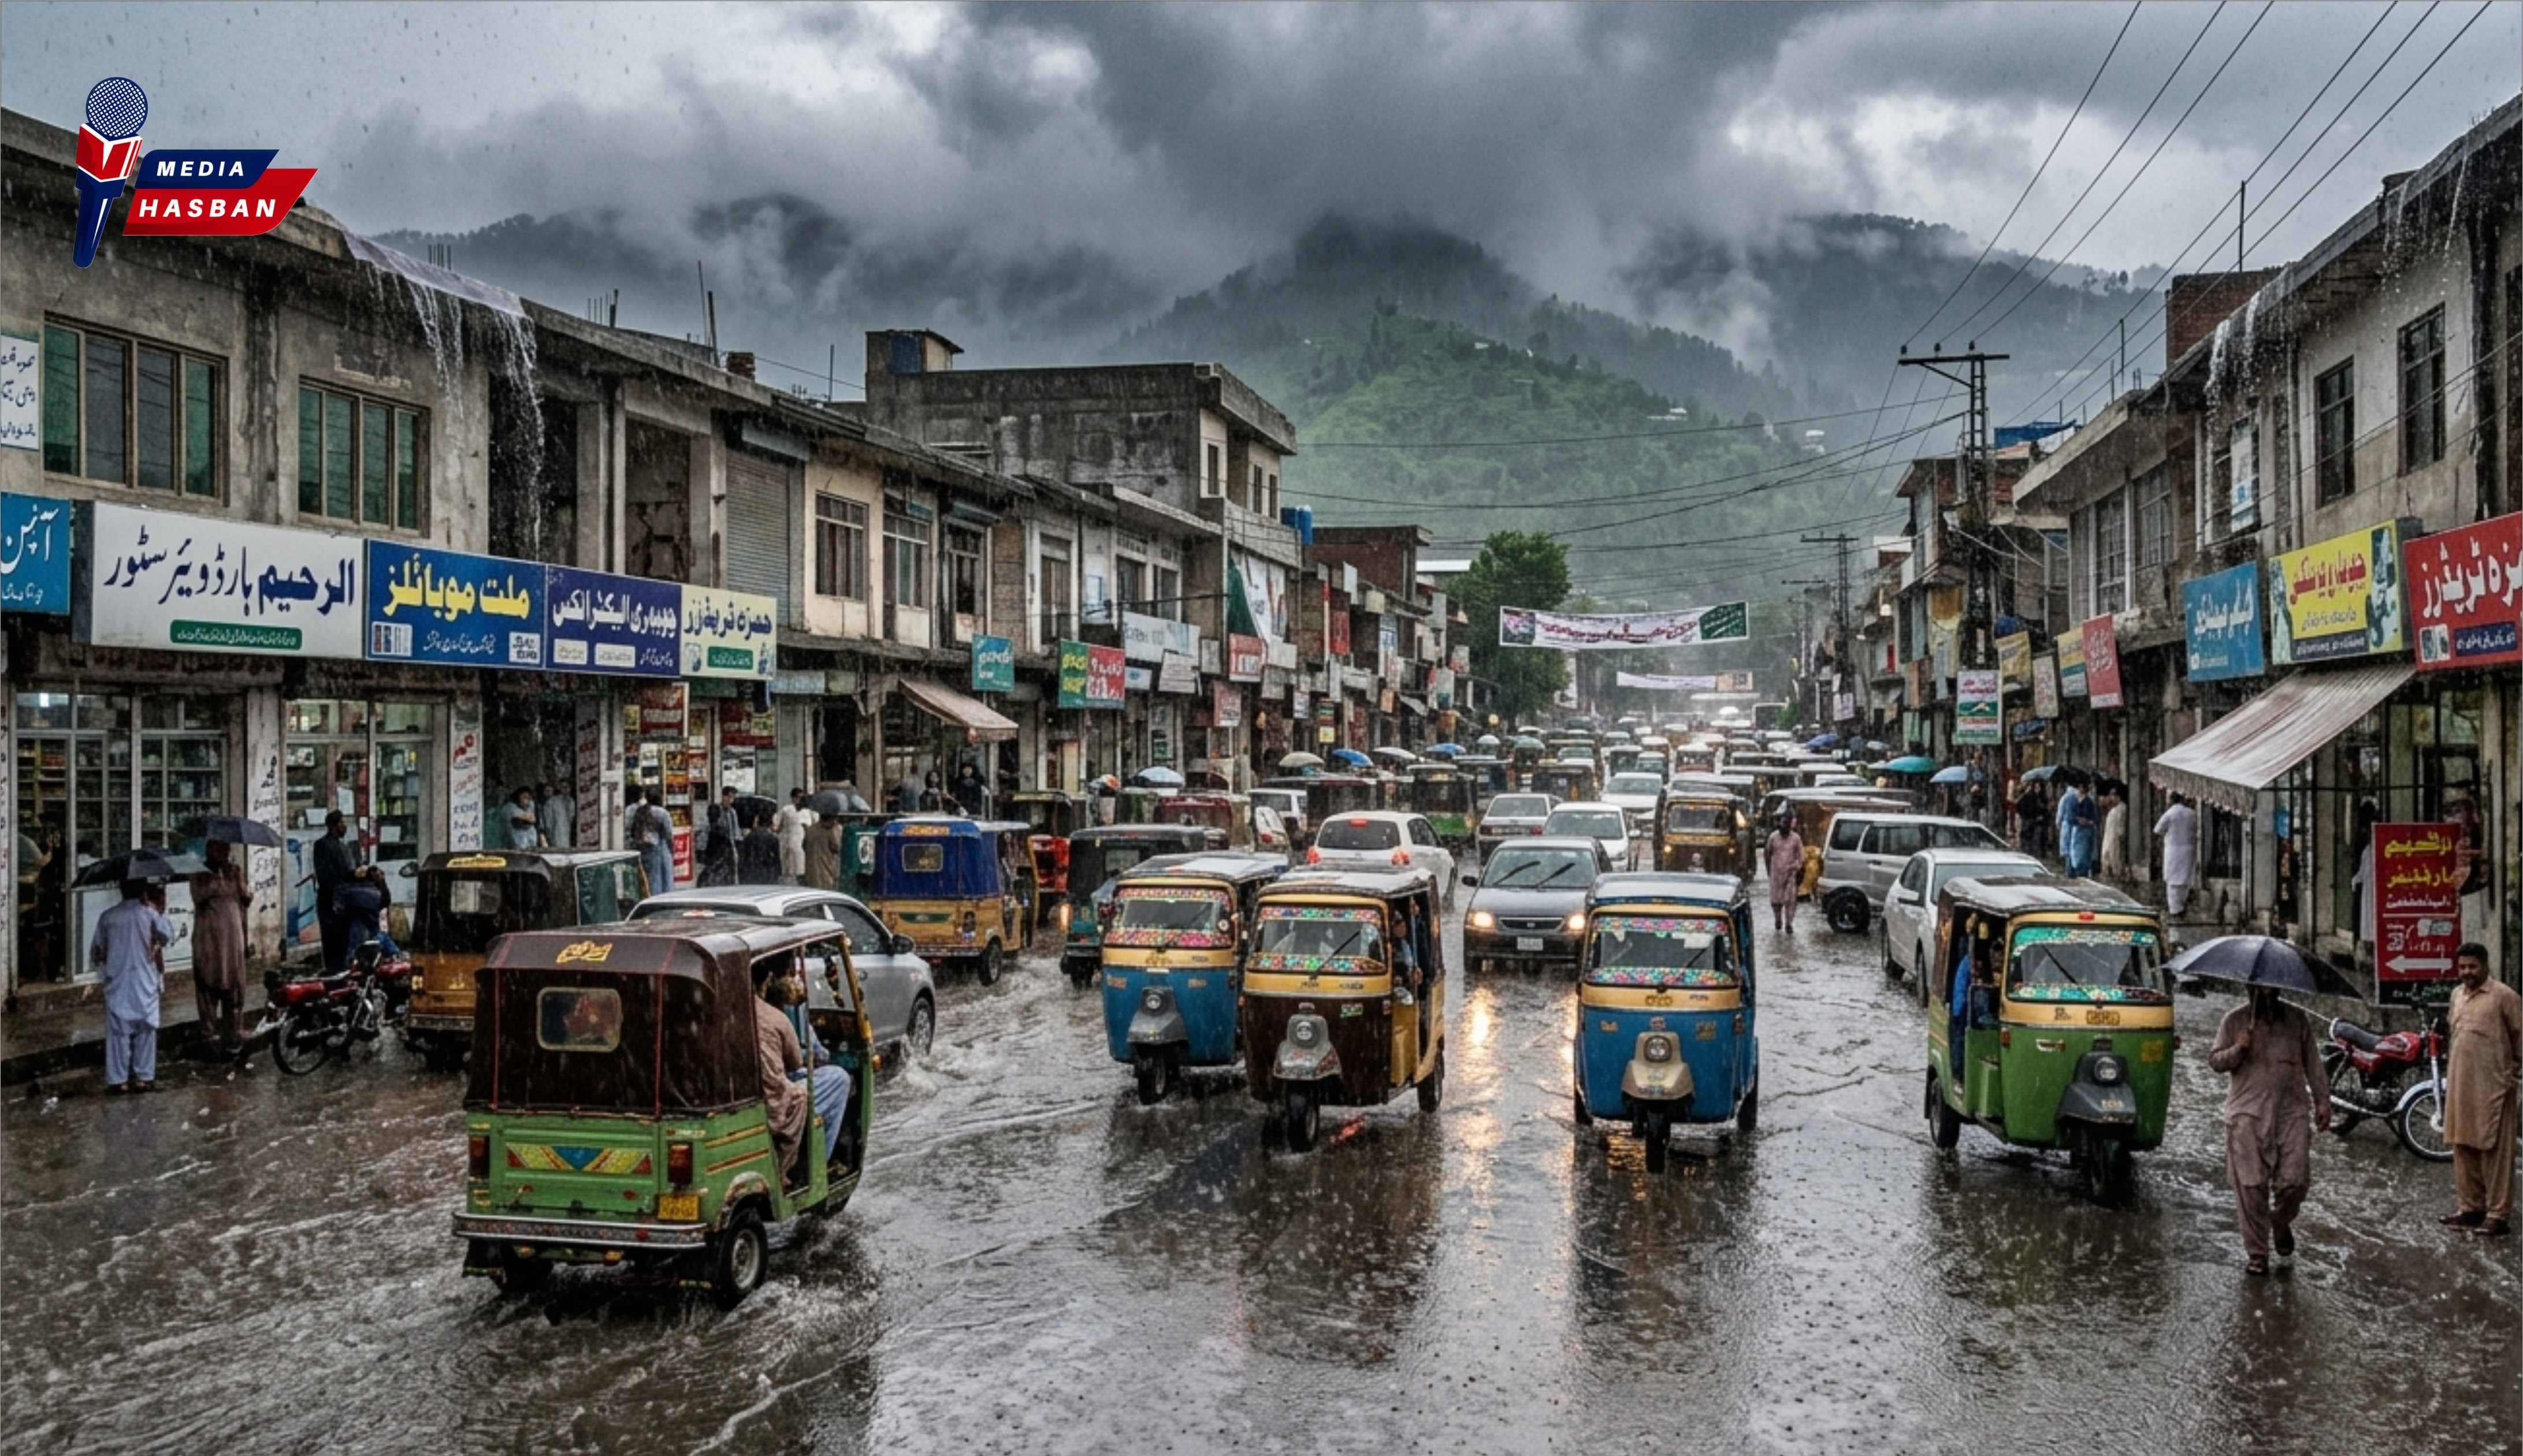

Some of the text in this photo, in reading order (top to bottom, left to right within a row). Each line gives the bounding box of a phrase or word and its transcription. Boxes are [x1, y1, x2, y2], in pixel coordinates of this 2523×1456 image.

[103, 524, 167, 587] سٹور
[258, 558, 354, 616] الرحیم
[480, 575, 530, 620] ملت
